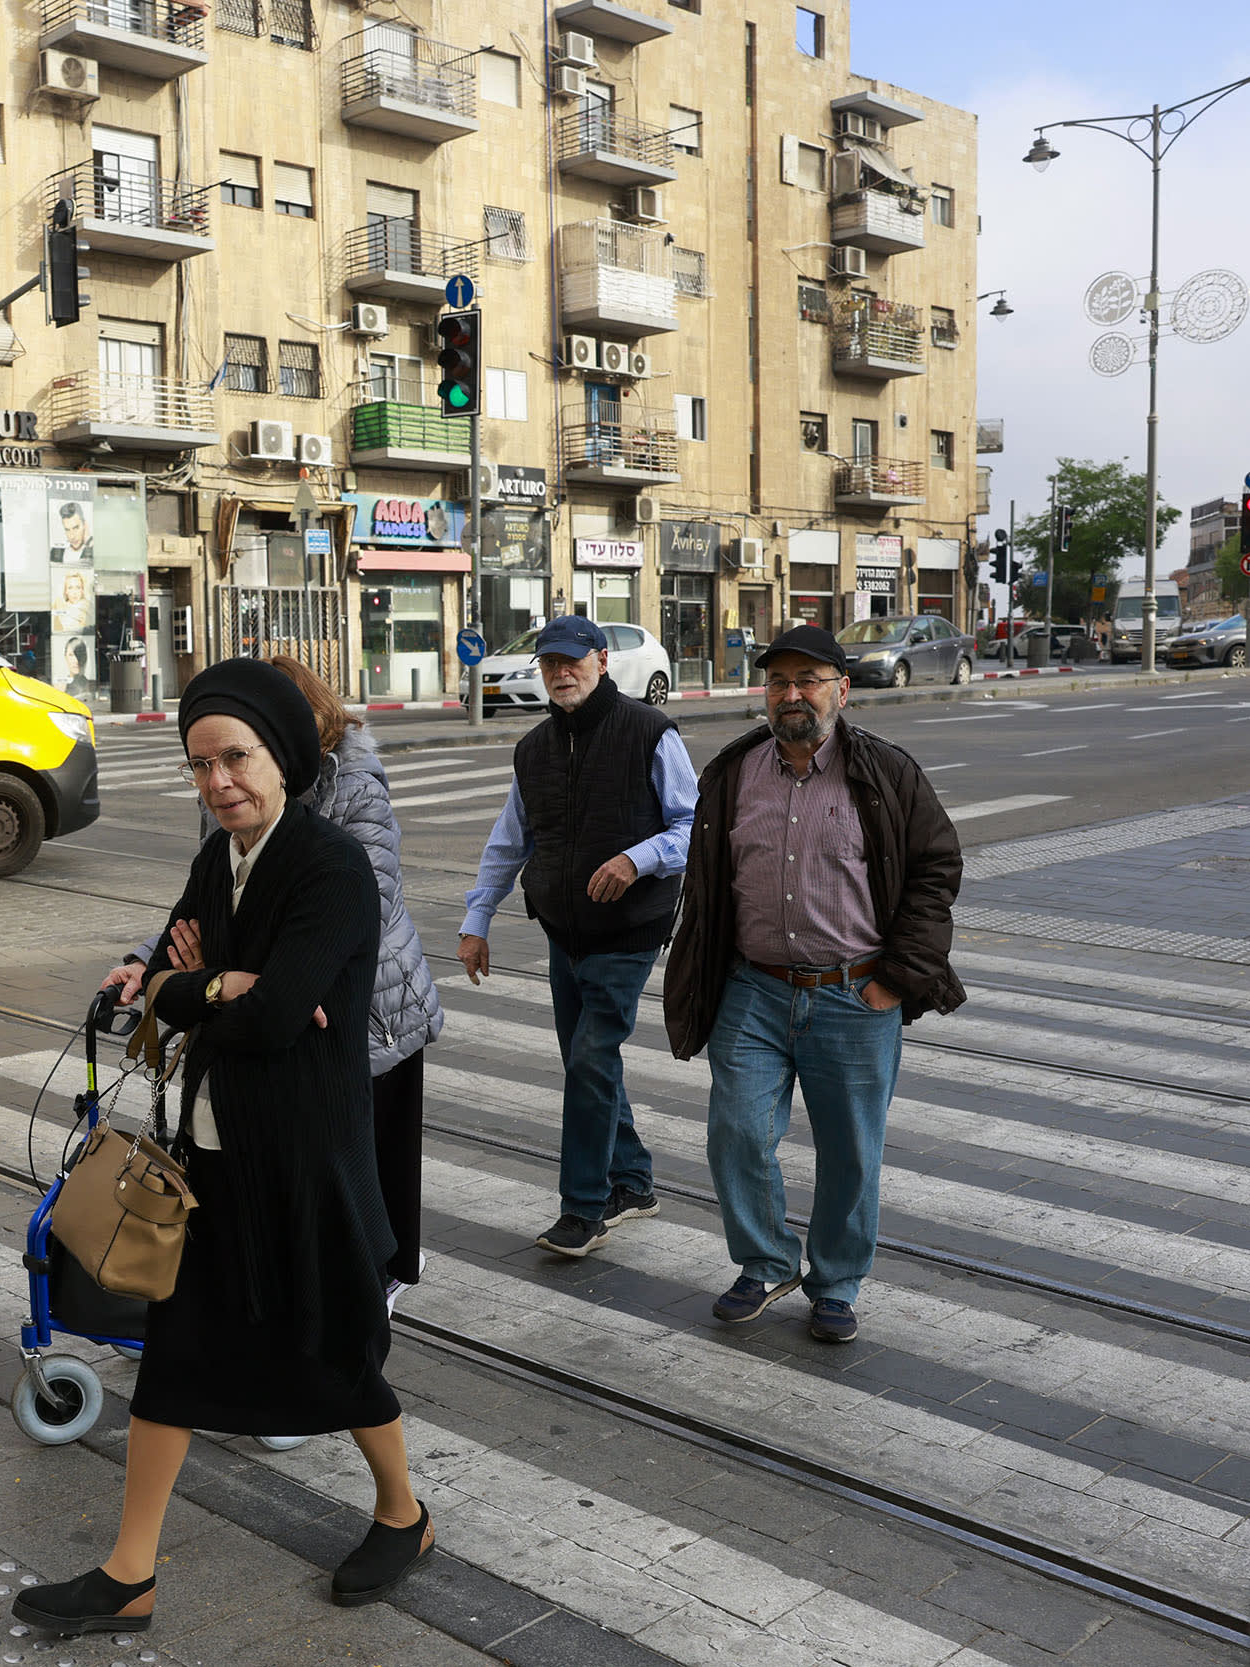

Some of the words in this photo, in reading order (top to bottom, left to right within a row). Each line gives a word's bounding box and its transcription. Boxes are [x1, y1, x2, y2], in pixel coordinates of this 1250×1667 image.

[56, 480, 89, 491] המרכז
[498, 479, 546, 496] ARTURO
[374, 499, 425, 523] AQUA
[374, 521, 427, 537] MADNESS
[585, 544, 606, 556] עדי
[610, 543, 636, 559] סלון
